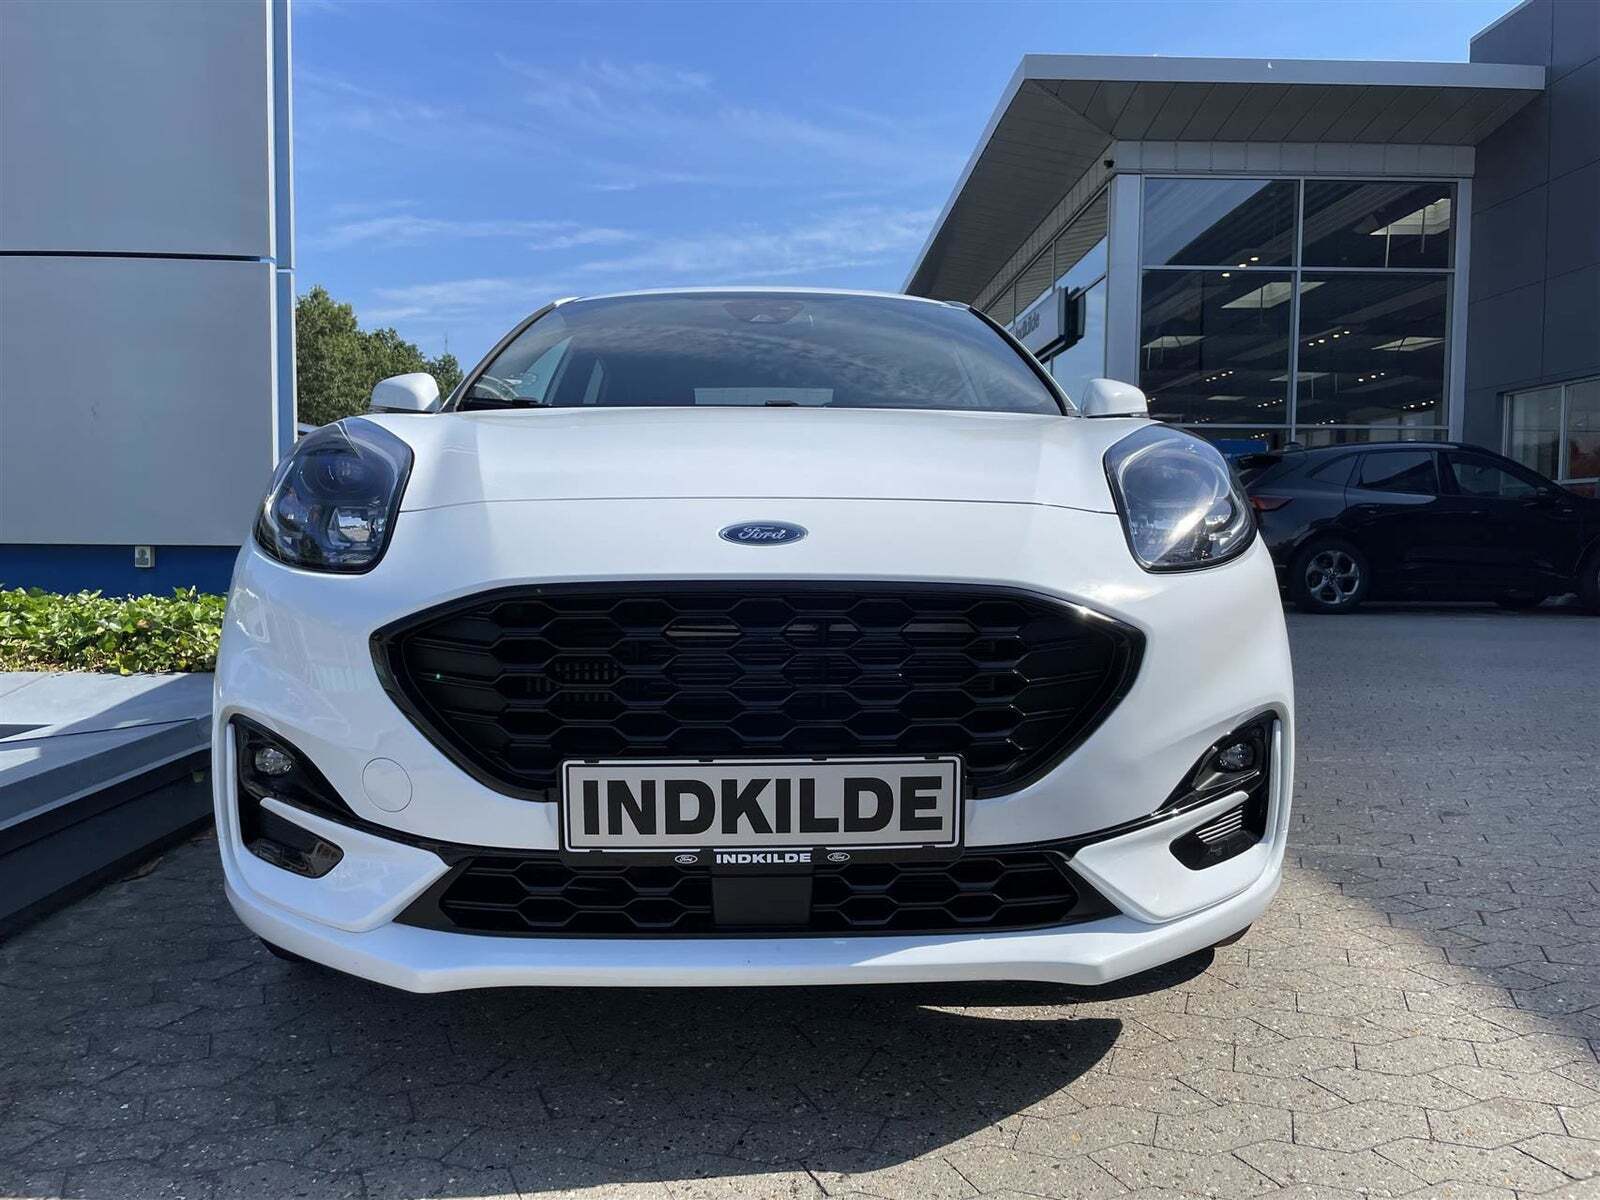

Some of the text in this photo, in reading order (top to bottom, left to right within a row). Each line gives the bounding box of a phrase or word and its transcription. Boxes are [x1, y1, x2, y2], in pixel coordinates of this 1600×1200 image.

[737, 526, 787, 540] Ford
[582, 775, 943, 836] INDKILDE
[716, 853, 812, 864] INDKILDE
